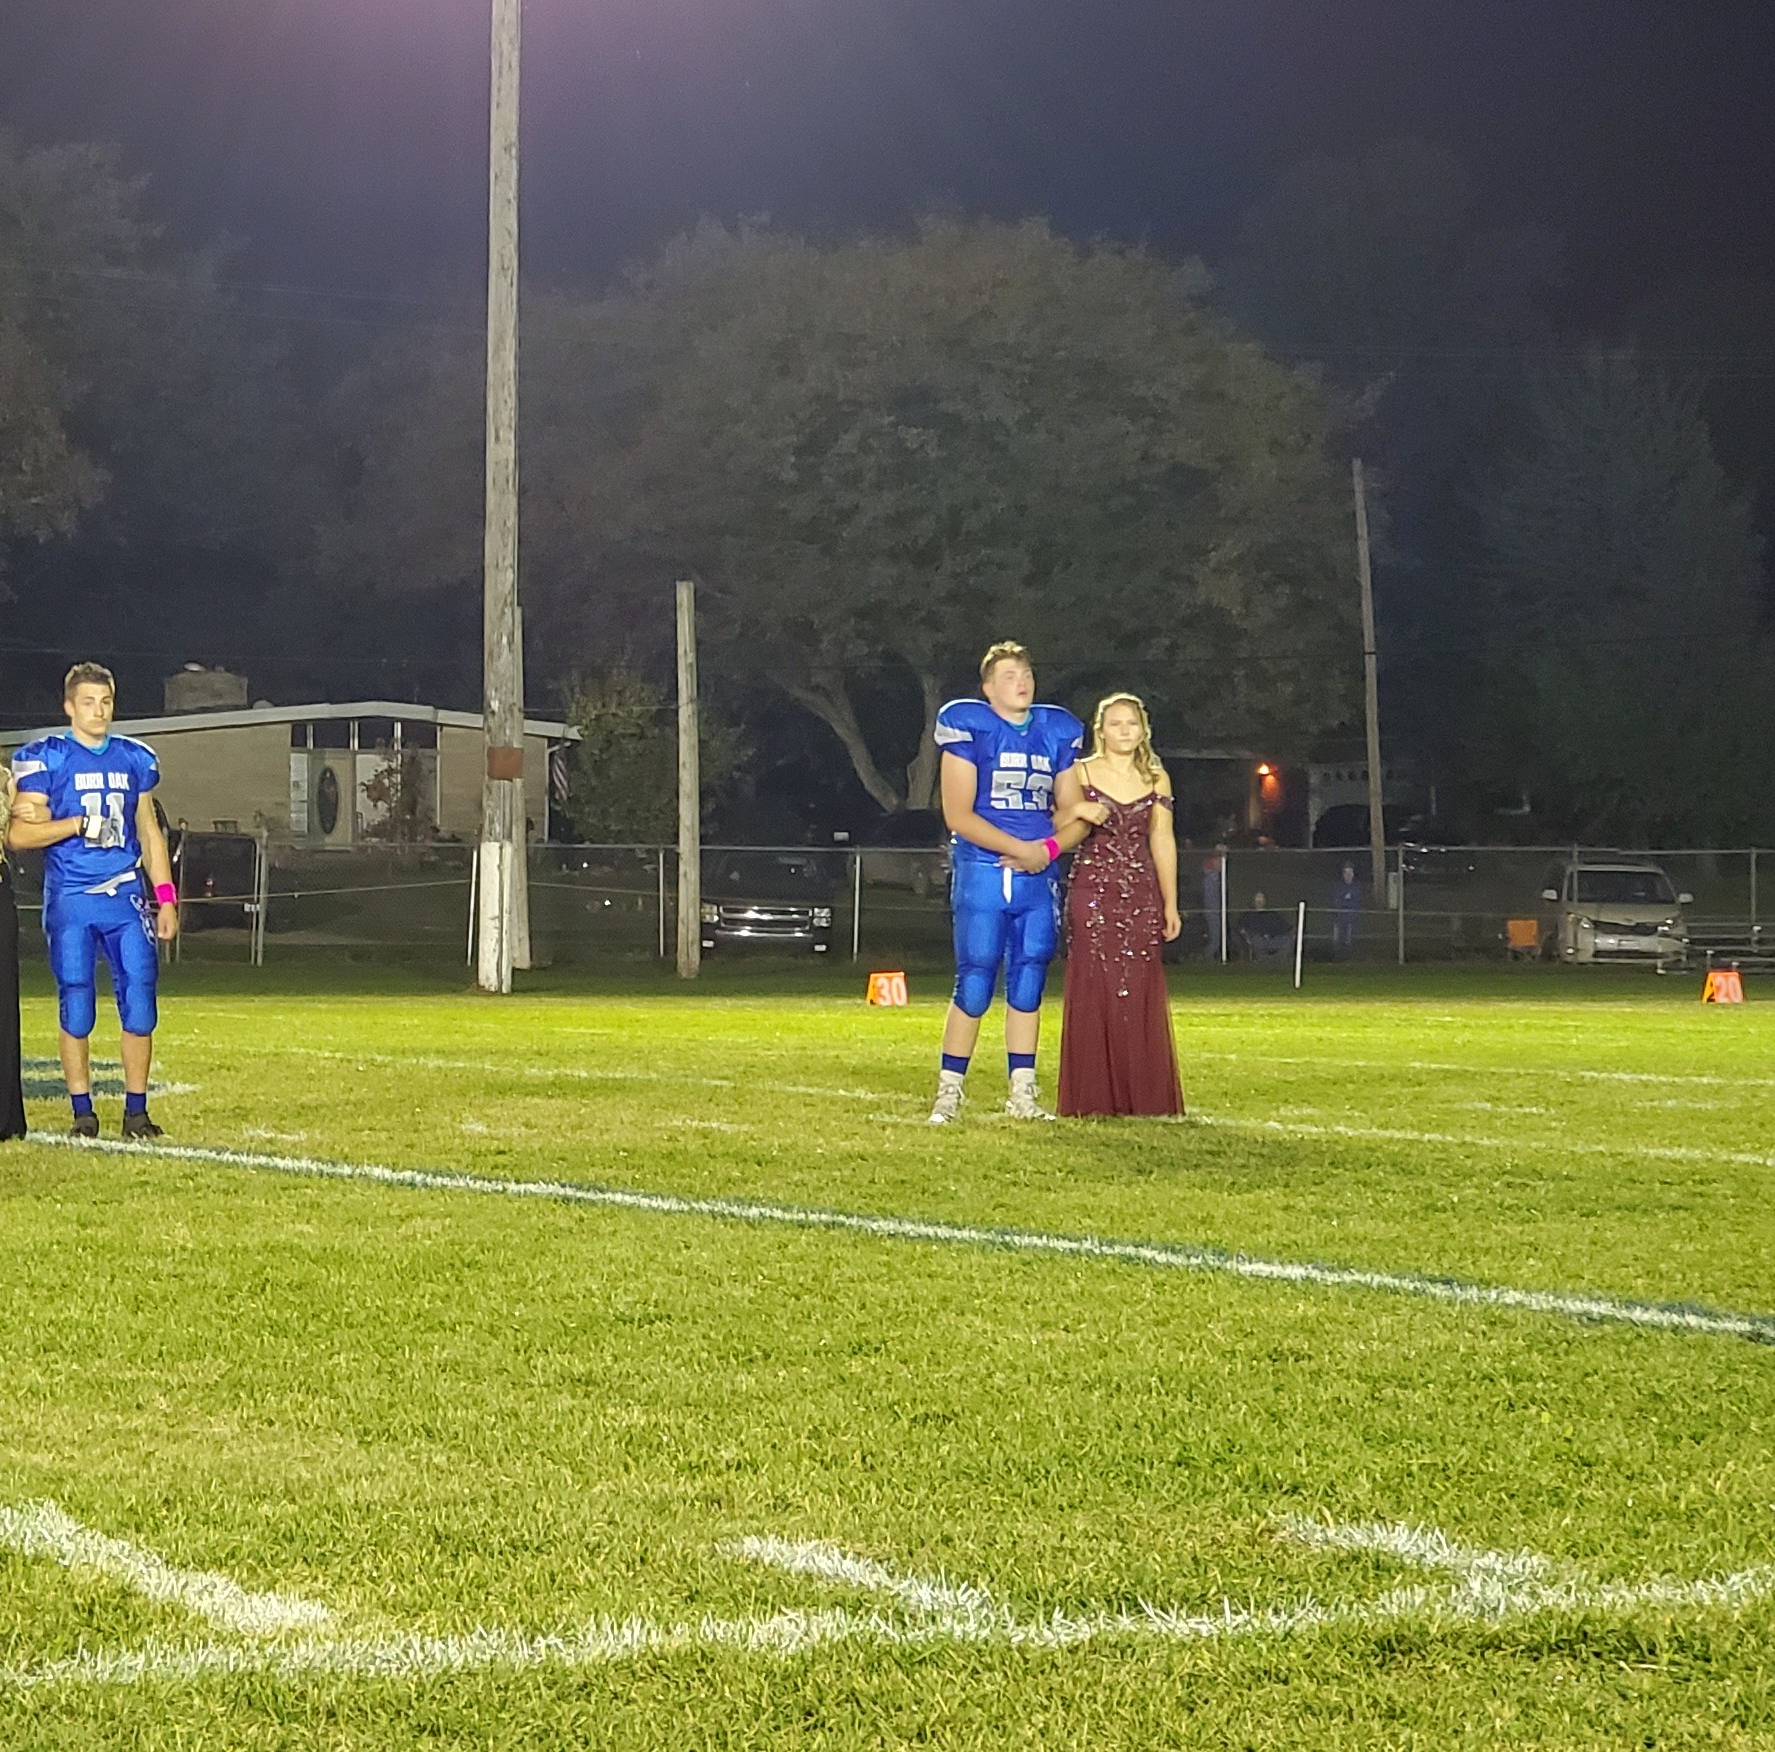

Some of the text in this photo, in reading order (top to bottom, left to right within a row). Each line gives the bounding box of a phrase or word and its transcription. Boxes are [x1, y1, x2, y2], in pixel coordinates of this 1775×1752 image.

[74, 772, 130, 790] BURR OAK
[80, 792, 126, 848] 11
[876, 976, 907, 1006] 30
[1714, 975, 1744, 1004] 20
